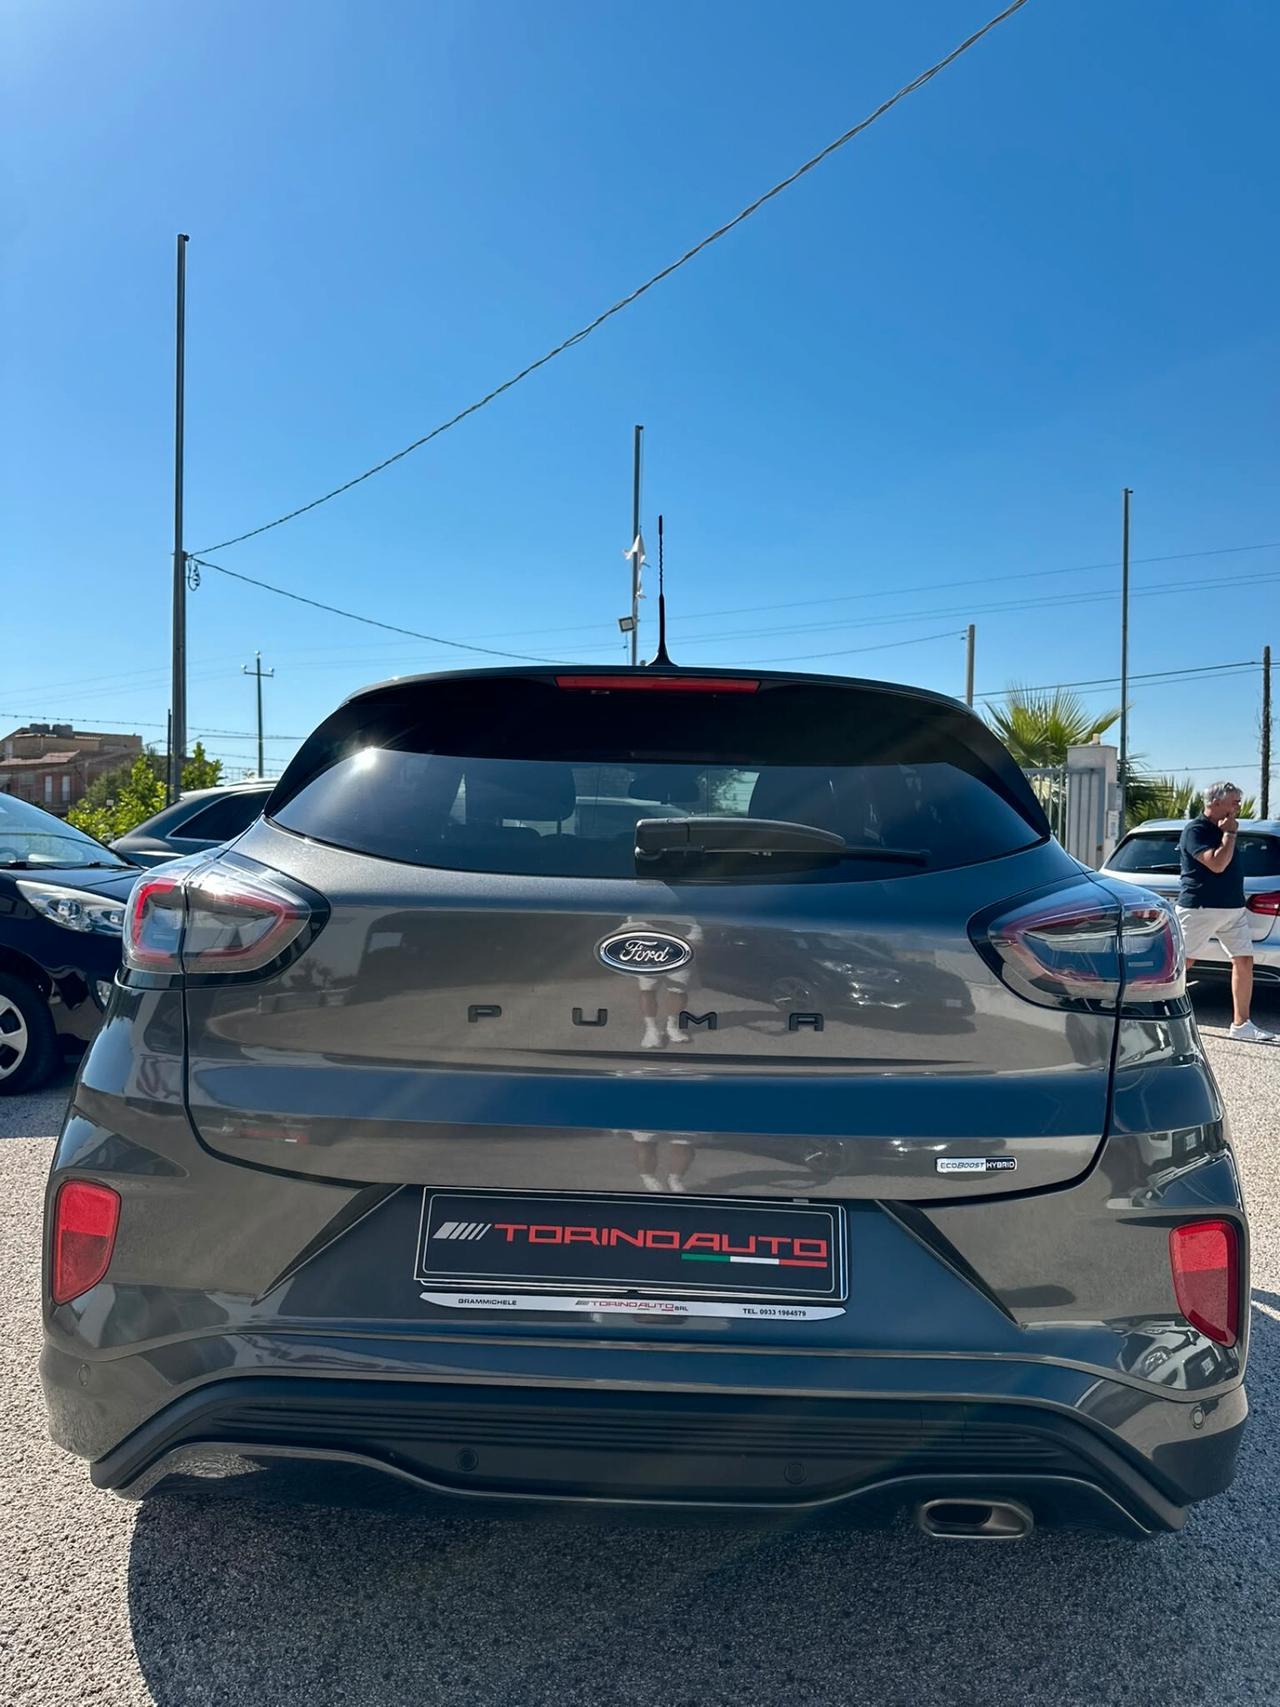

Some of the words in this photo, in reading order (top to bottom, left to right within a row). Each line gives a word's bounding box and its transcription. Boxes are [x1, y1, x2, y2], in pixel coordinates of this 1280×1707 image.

[619, 939, 669, 962] Ford
[467, 1004, 824, 1032] PUMA
[986, 1160, 1015, 1169] HYBRID
[494, 1222, 828, 1258] TORINOAUTO
[742, 1307, 758, 1315] TEL.
[759, 1308, 777, 1316] 0933
